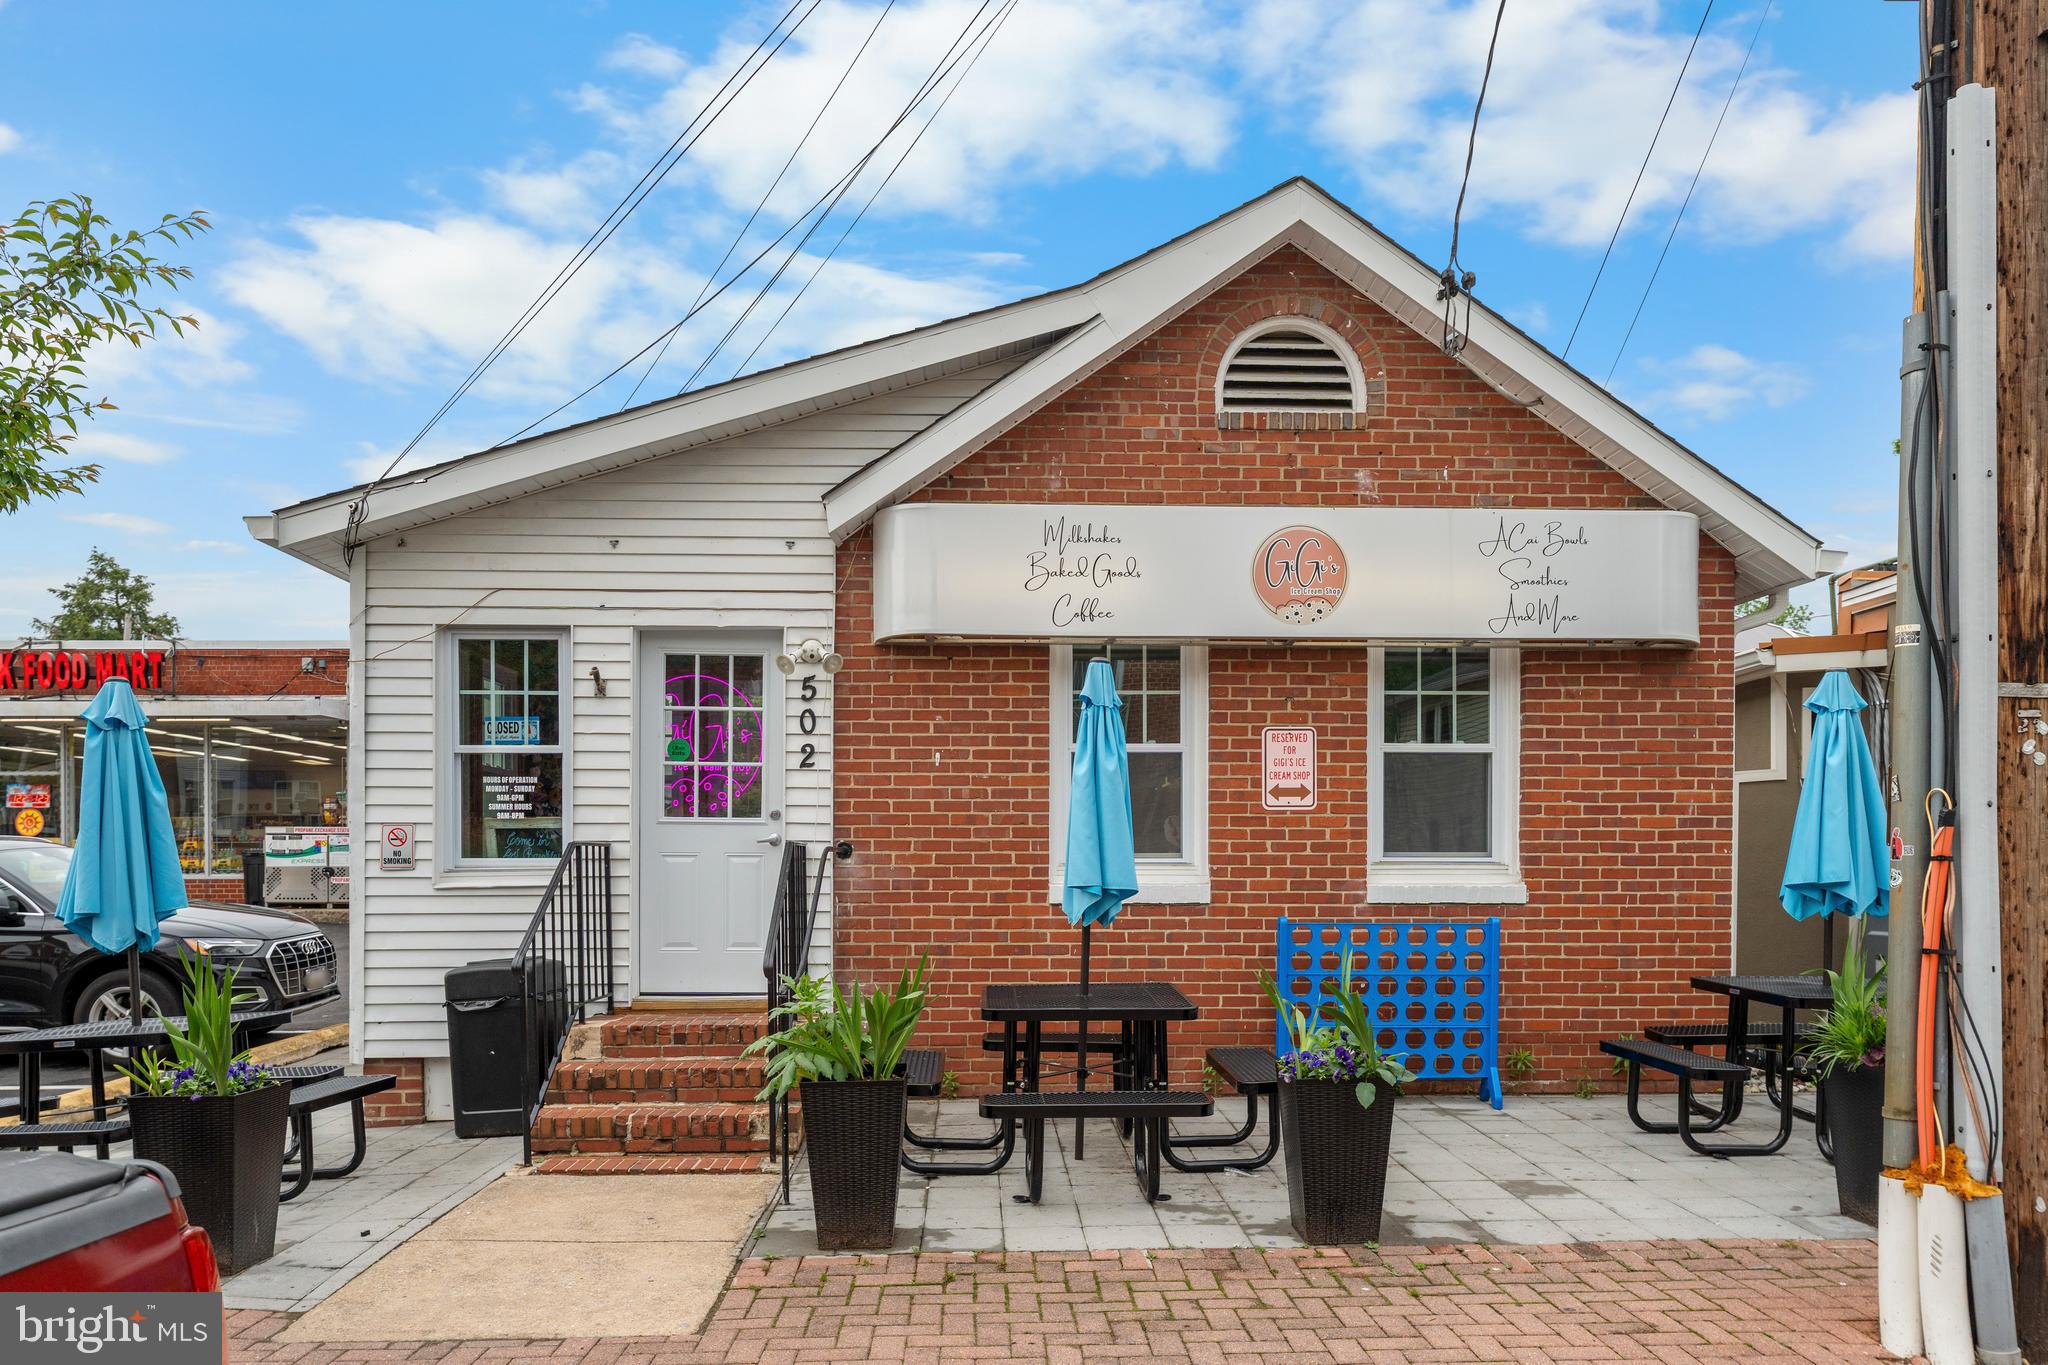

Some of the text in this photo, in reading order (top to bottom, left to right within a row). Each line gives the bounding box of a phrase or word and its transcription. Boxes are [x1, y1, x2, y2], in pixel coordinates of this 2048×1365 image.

[1044, 515, 1121, 555] Milkshakes
[1542, 521, 1590, 556] Bowls
[1024, 551, 1141, 591] Baked Goods
[1264, 537, 1340, 588] GiGi's
[1498, 557, 1568, 590] Smoothies
[1325, 587, 1341, 596] Shop
[1052, 593, 1114, 627] Coffee
[1487, 593, 1580, 633] And More
[23, 651, 88, 689] FOOD
[95, 651, 162, 689] MART
[486, 721, 520, 734] COSED
[799, 674, 817, 768] 502
[1271, 733, 1308, 743] RESERVED
[1283, 745, 1297, 755] FOR
[1269, 771, 1311, 780] CREAM SHOP
[1273, 757, 1307, 767] GIGI'S ICE
[383, 857, 412, 865] SMOKING
